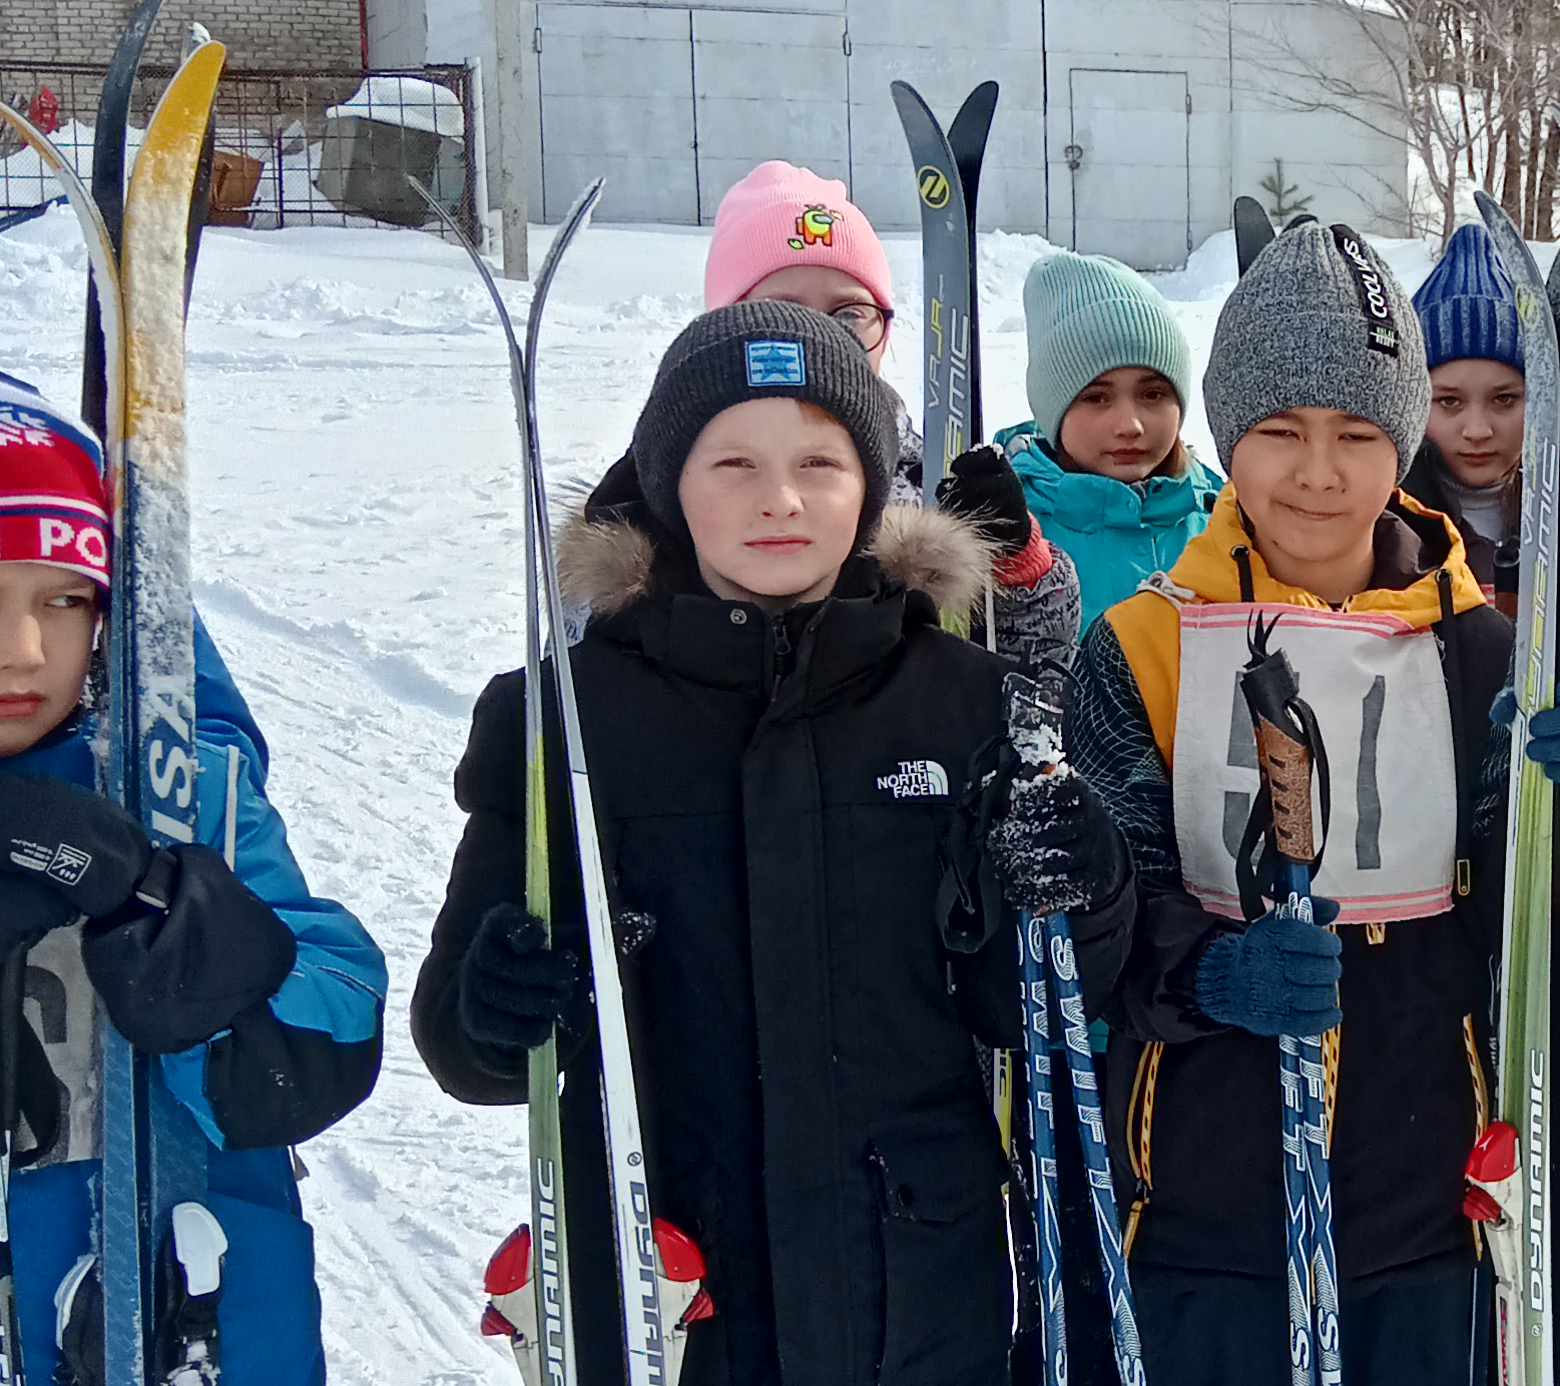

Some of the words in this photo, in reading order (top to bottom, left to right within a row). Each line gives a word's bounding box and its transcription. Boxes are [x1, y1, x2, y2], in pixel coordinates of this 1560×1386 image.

[1362, 274, 1387, 318] COOL
[943, 307, 969, 477] AMIC
[1526, 437, 1557, 711] YNAMIC
[877, 773, 928, 790] NORTH
[893, 783, 929, 799] FACE
[898, 760, 926, 773] THE
[1050, 935, 1115, 1204] SWIFT
[1529, 1049, 1545, 1312] DYNAMIC
